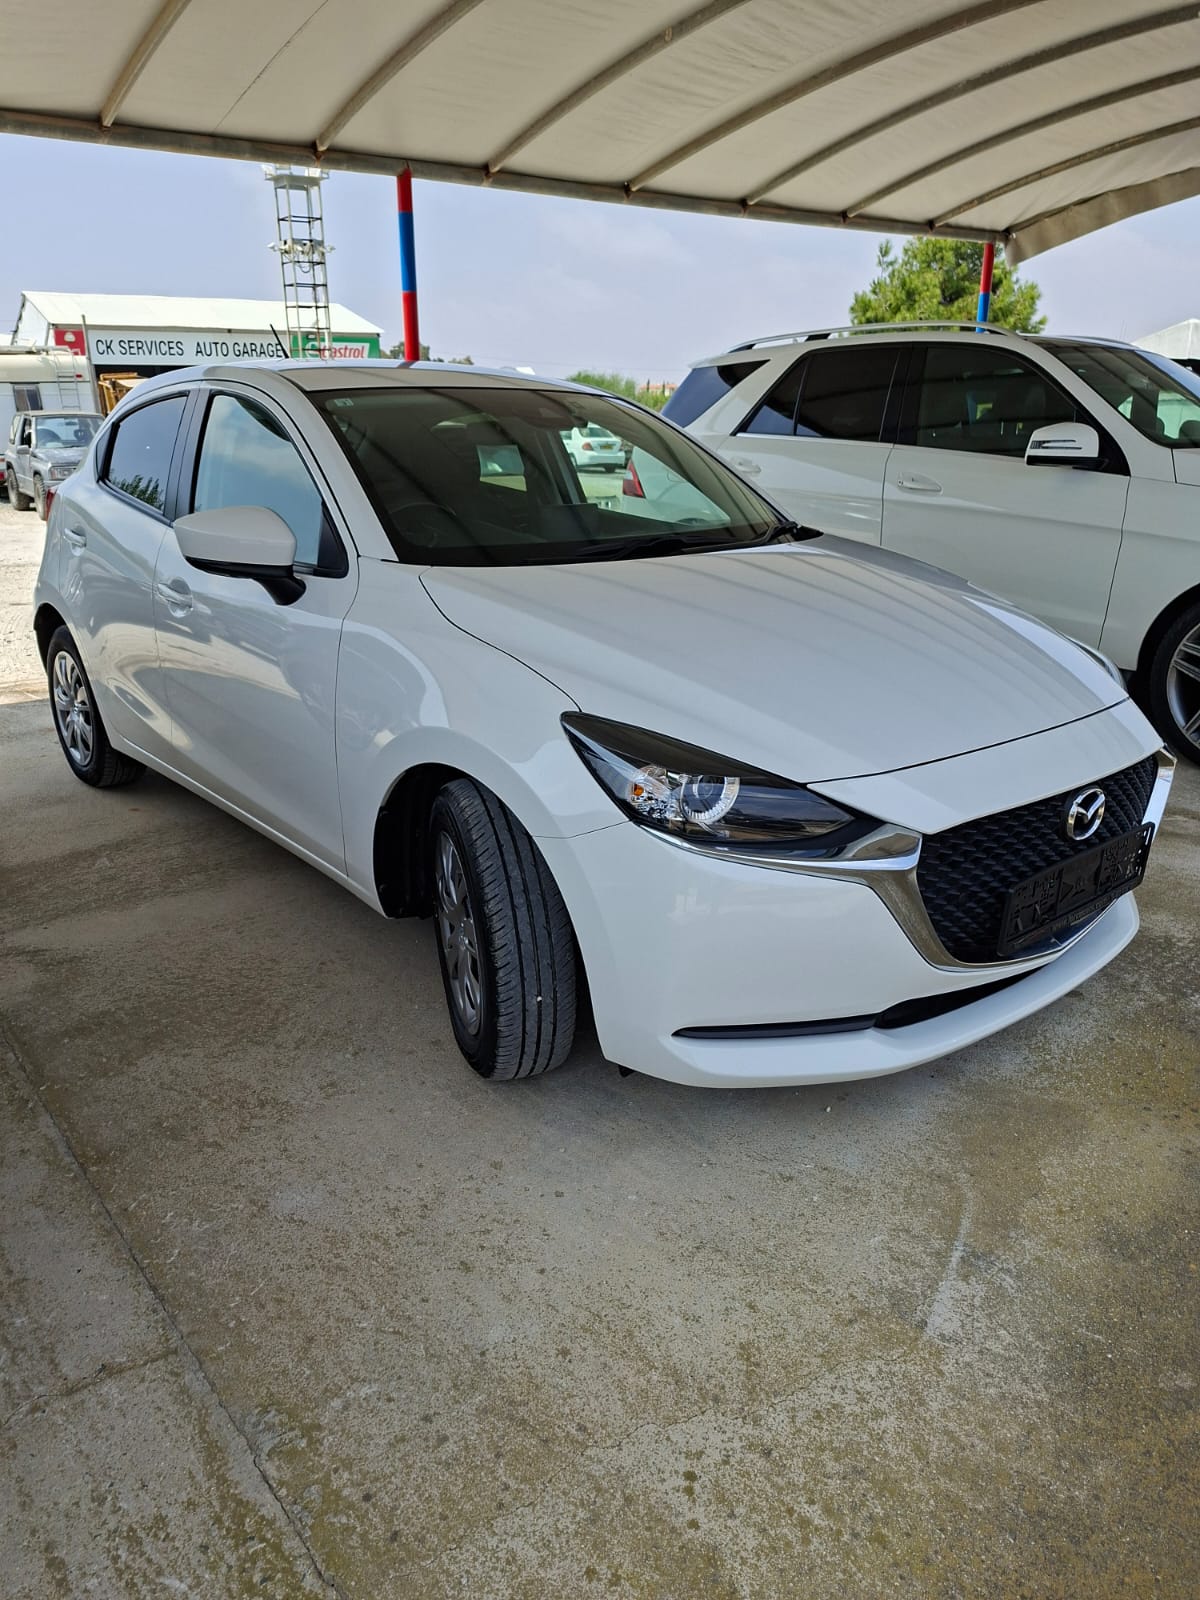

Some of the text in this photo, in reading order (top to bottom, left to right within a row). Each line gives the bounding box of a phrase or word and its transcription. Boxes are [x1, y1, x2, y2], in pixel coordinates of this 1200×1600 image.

[95, 339, 283, 358] CK SERVICES AUTO GARAGE
